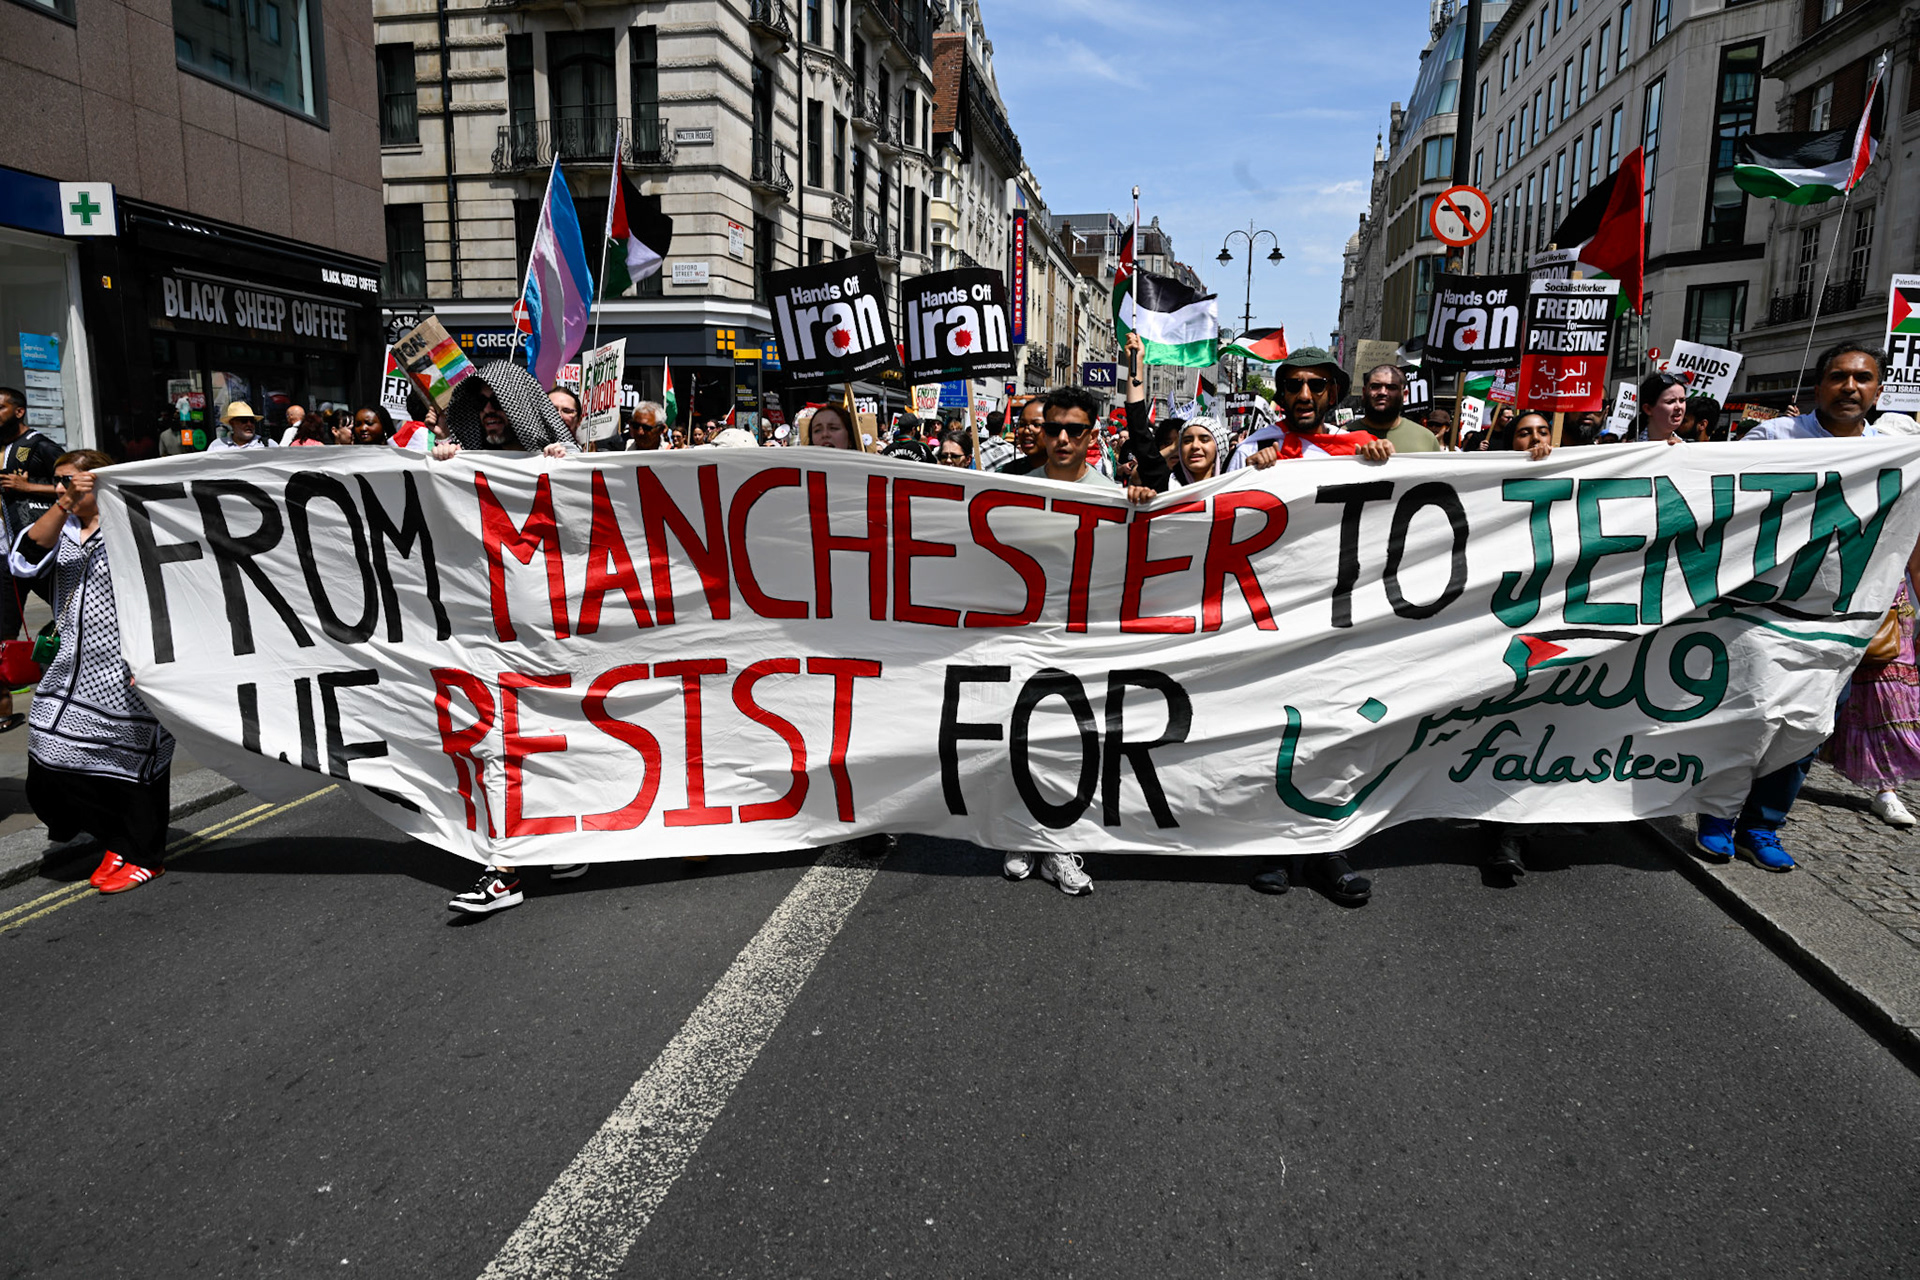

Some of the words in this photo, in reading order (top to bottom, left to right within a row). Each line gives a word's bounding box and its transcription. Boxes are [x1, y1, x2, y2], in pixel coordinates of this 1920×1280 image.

[677, 130, 694, 140] WALTER
[695, 130, 712, 140] HOUSE
[322, 268, 341, 285] BLACK
[341, 271, 358, 287] SHEEP
[358, 276, 378, 293] COFFEE
[790, 282, 842, 305] Hands
[843, 275, 860, 297] Off
[921, 286, 968, 309] Hands
[971, 284, 992, 301] Off
[1443, 289, 1483, 306] Hands
[1485, 288, 1508, 305] Off
[162, 276, 229, 325] BLACK
[233, 289, 286, 332] SHEEP
[291, 300, 348, 341] COFFEE
[1535, 298, 1609, 320] FREEDOM
[774, 294, 887, 362] Iran
[908, 304, 1009, 361] Iran
[1427, 292, 1519, 352] Iran
[1566, 320, 1578, 331] for
[476, 333, 527, 347] GREGG
[1528, 330, 1607, 352] PALESTINE
[1538, 360, 1587, 382] الحرية
[1675, 352, 1730, 378] HANDS
[384, 377, 409, 396] FR
[1233, 393, 1250, 401] Free
[1528, 380, 1592, 400] لفلسطين
[1883, 385, 1898, 393] END
[855, 402, 878, 414] ran
[1226, 401, 1255, 409] Palestin
[118, 469, 451, 664] FROM
[474, 464, 1290, 643] MANCHESTER
[1316, 481, 1470, 628] TO
[1490, 468, 1904, 628] JENIN
[429, 657, 883, 838] RESIST
[938, 664, 1193, 830] FOR
